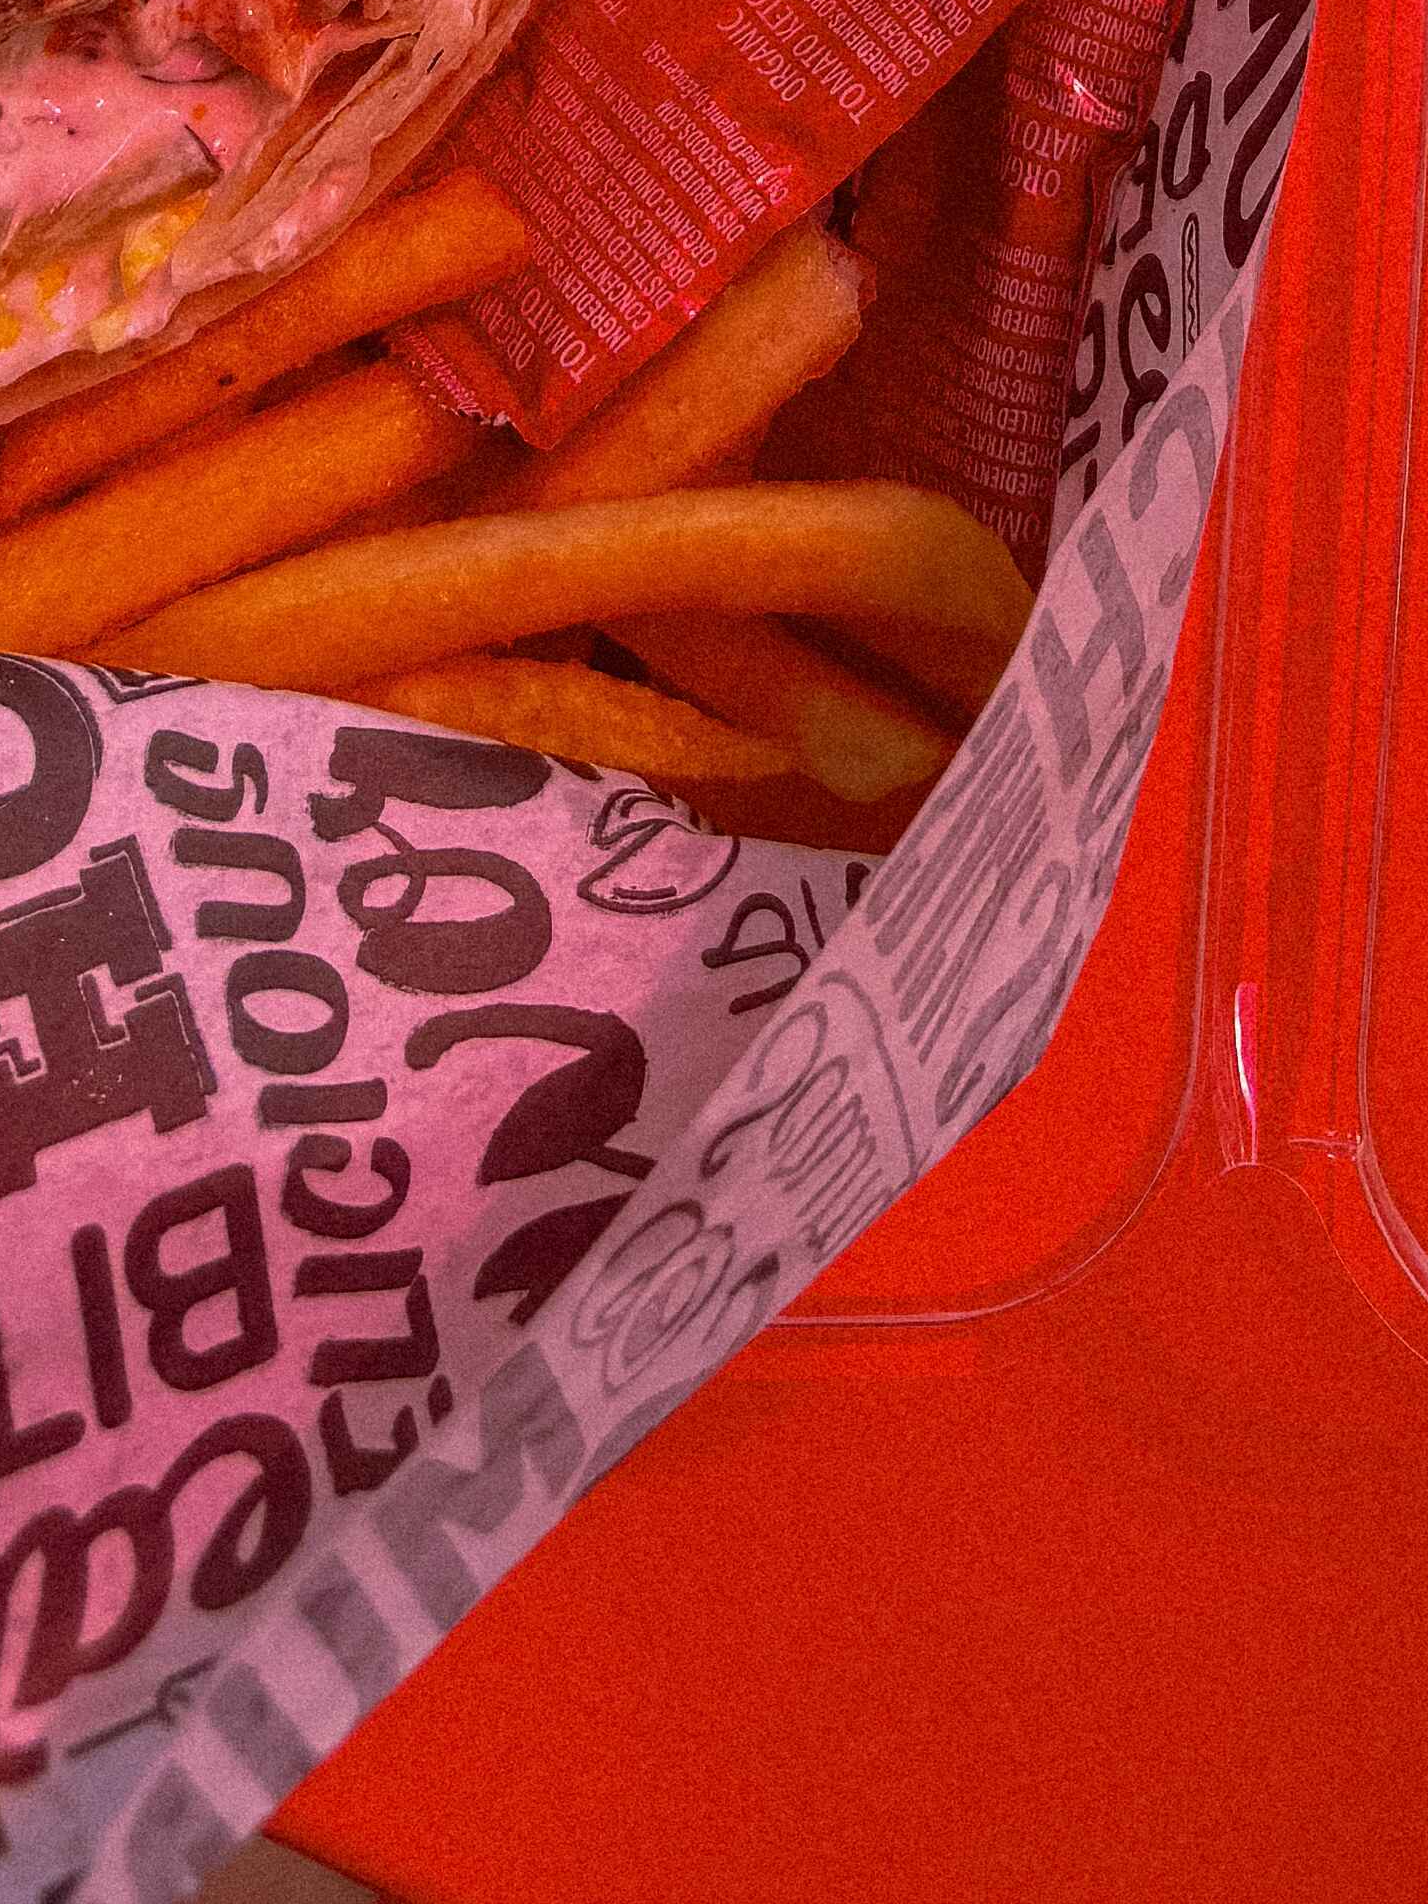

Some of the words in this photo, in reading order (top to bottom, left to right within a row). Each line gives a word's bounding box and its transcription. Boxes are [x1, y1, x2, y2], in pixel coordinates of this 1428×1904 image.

[640, 37, 667, 65] SA
[654, 51, 700, 100] Ecocert
[715, 4, 809, 105] ORGANIC
[789, 29, 880, 126] TOMATO
[824, 5, 911, 99] INGREDIENTS:
[686, 85, 713, 110] by
[698, 95, 750, 156] Organic
[550, 124, 609, 186] ORGANIC
[620, 155, 667, 209] ONION
[652, 95, 768, 222] WWW.USFOODS.COM
[518, 179, 572, 239] ORGANIC
[653, 195, 720, 269] ORGANIC
[666, 153, 746, 243] DISTRIBUTED
[604, 232, 678, 311] DISTILLED
[632, 215, 698, 291] ORGANIC
[470, 287, 540, 371] ORGAN
[513, 284, 602, 384] TOMATO
[541, 252, 633, 354] INGREDIENTS:
[140, 728, 451, 1499] ELICIOUS
